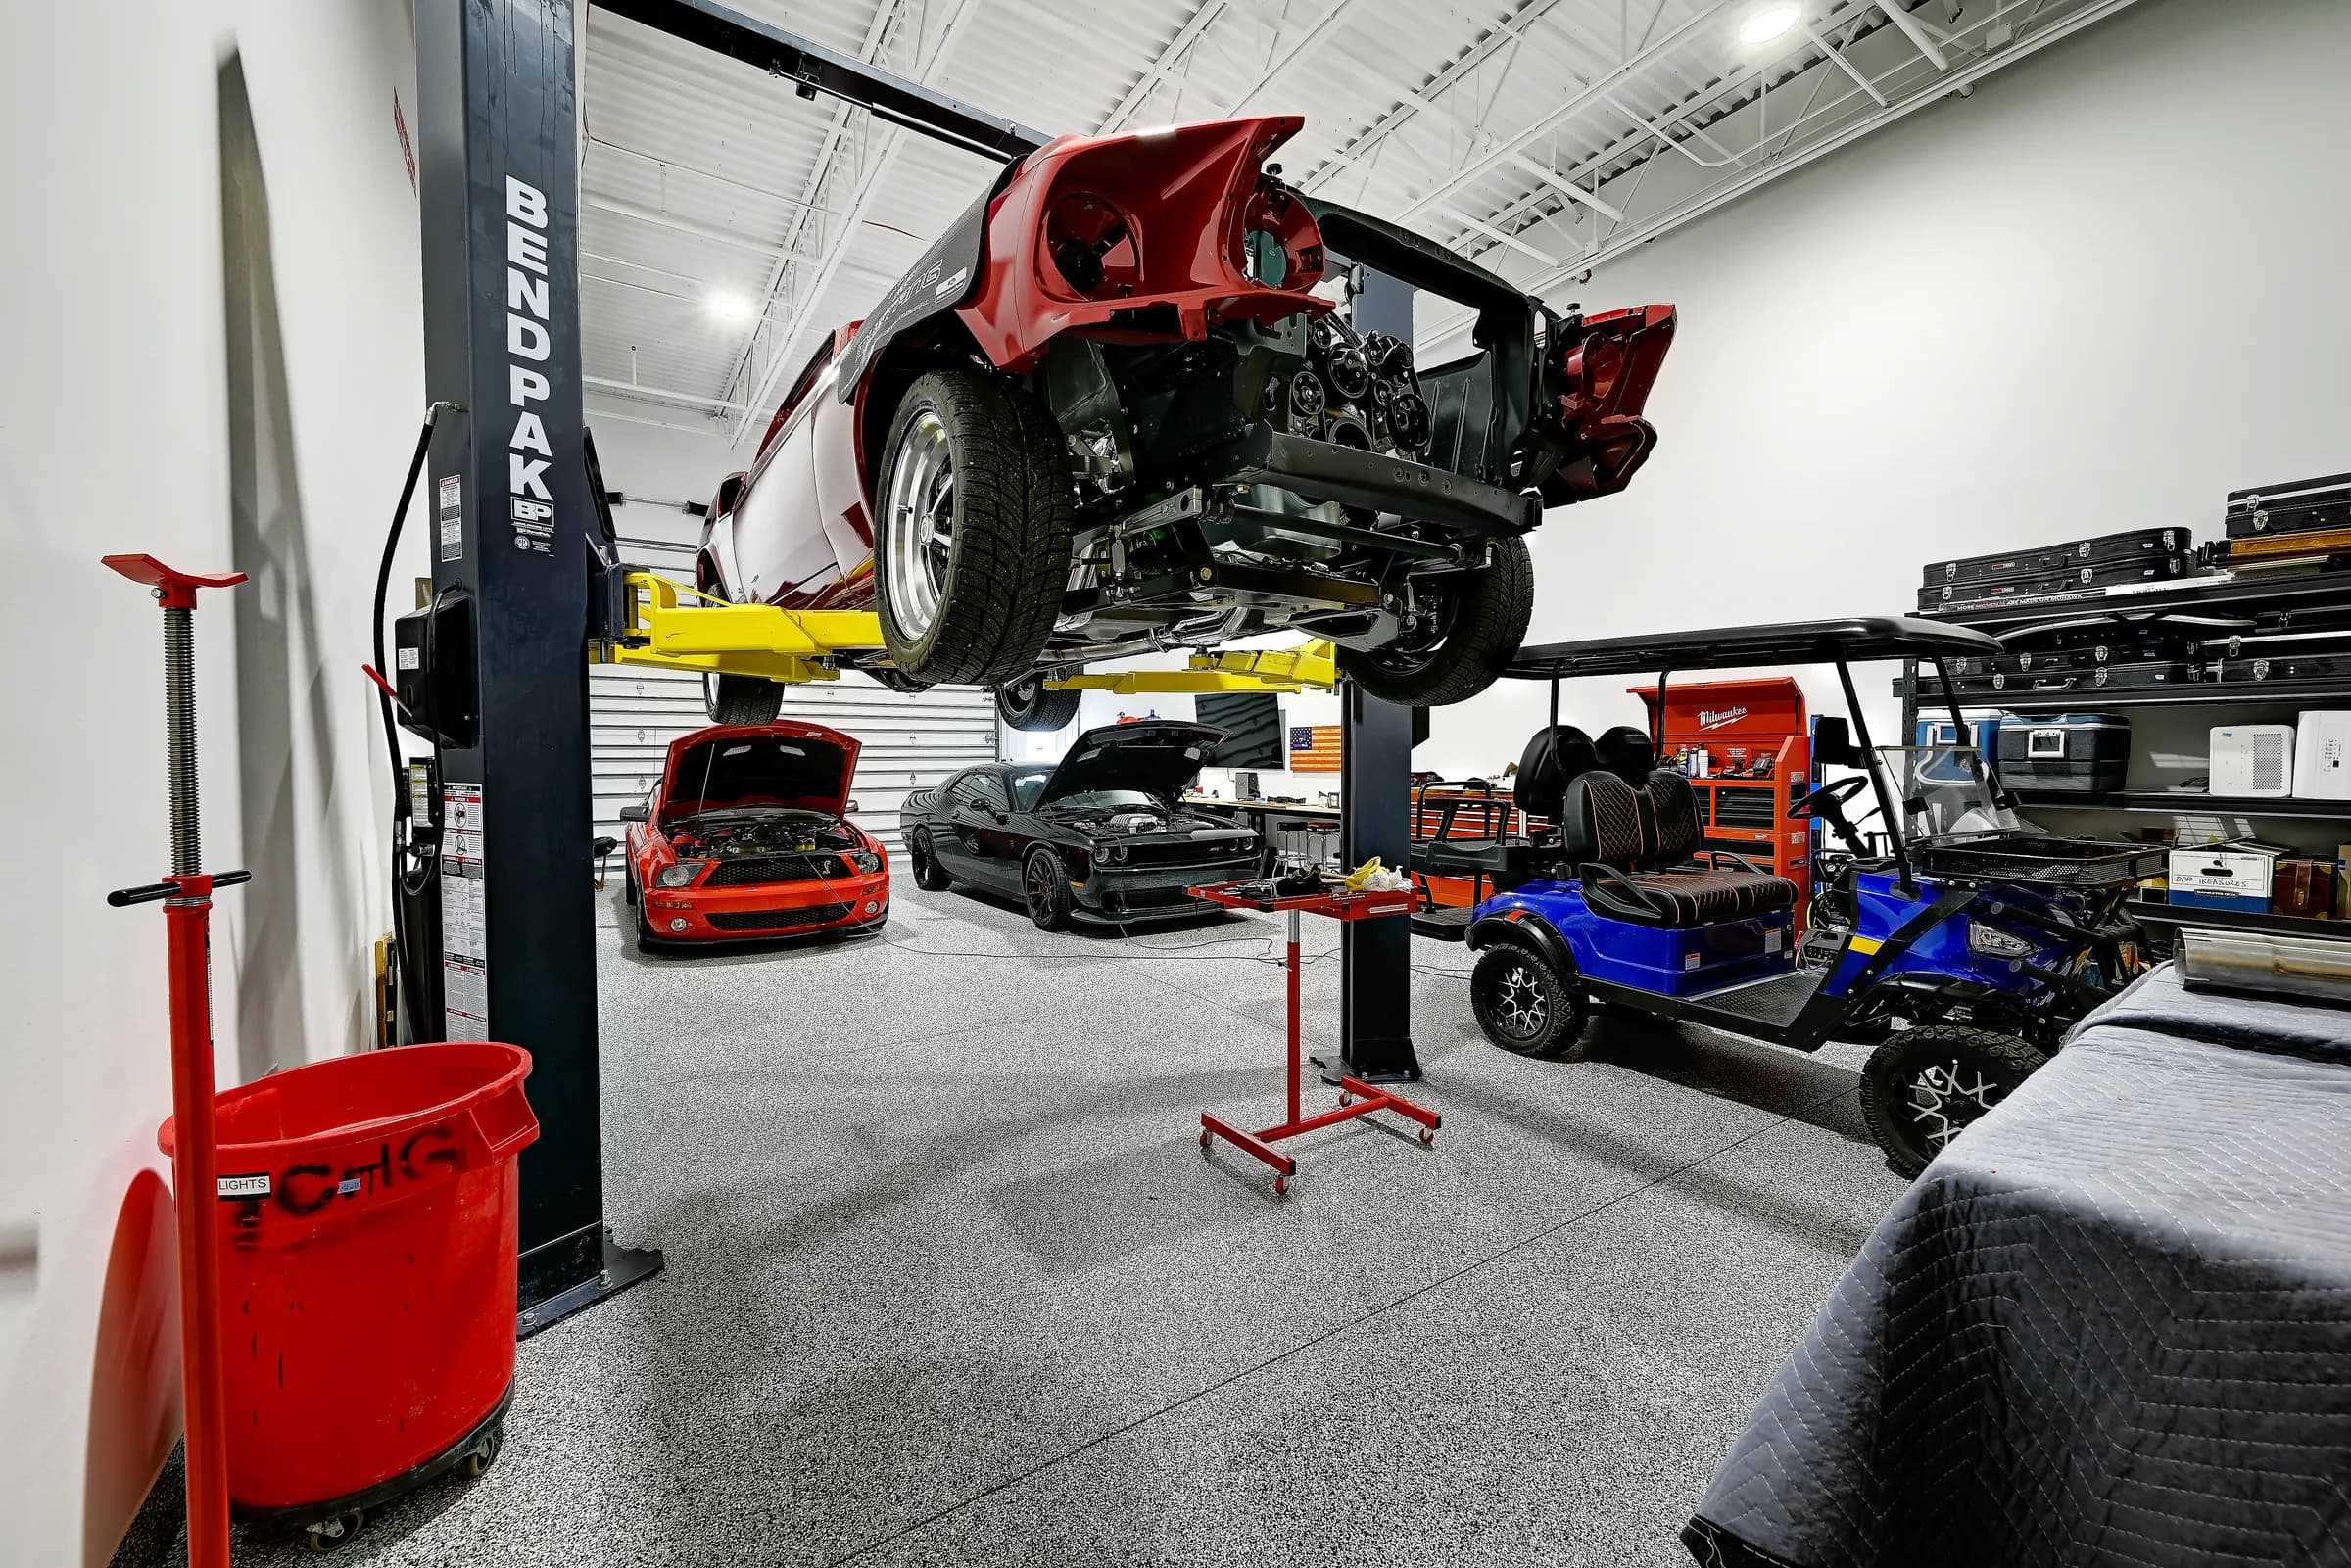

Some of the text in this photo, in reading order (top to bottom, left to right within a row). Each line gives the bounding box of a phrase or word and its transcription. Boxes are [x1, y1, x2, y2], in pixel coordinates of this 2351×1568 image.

[506, 174, 553, 500] BENDPAK
[513, 499, 552, 521] BP
[1697, 706, 1748, 726] Milwaukee
[2197, 878, 2247, 887] TREASURES
[218, 1178, 266, 1191] LIGHTS
